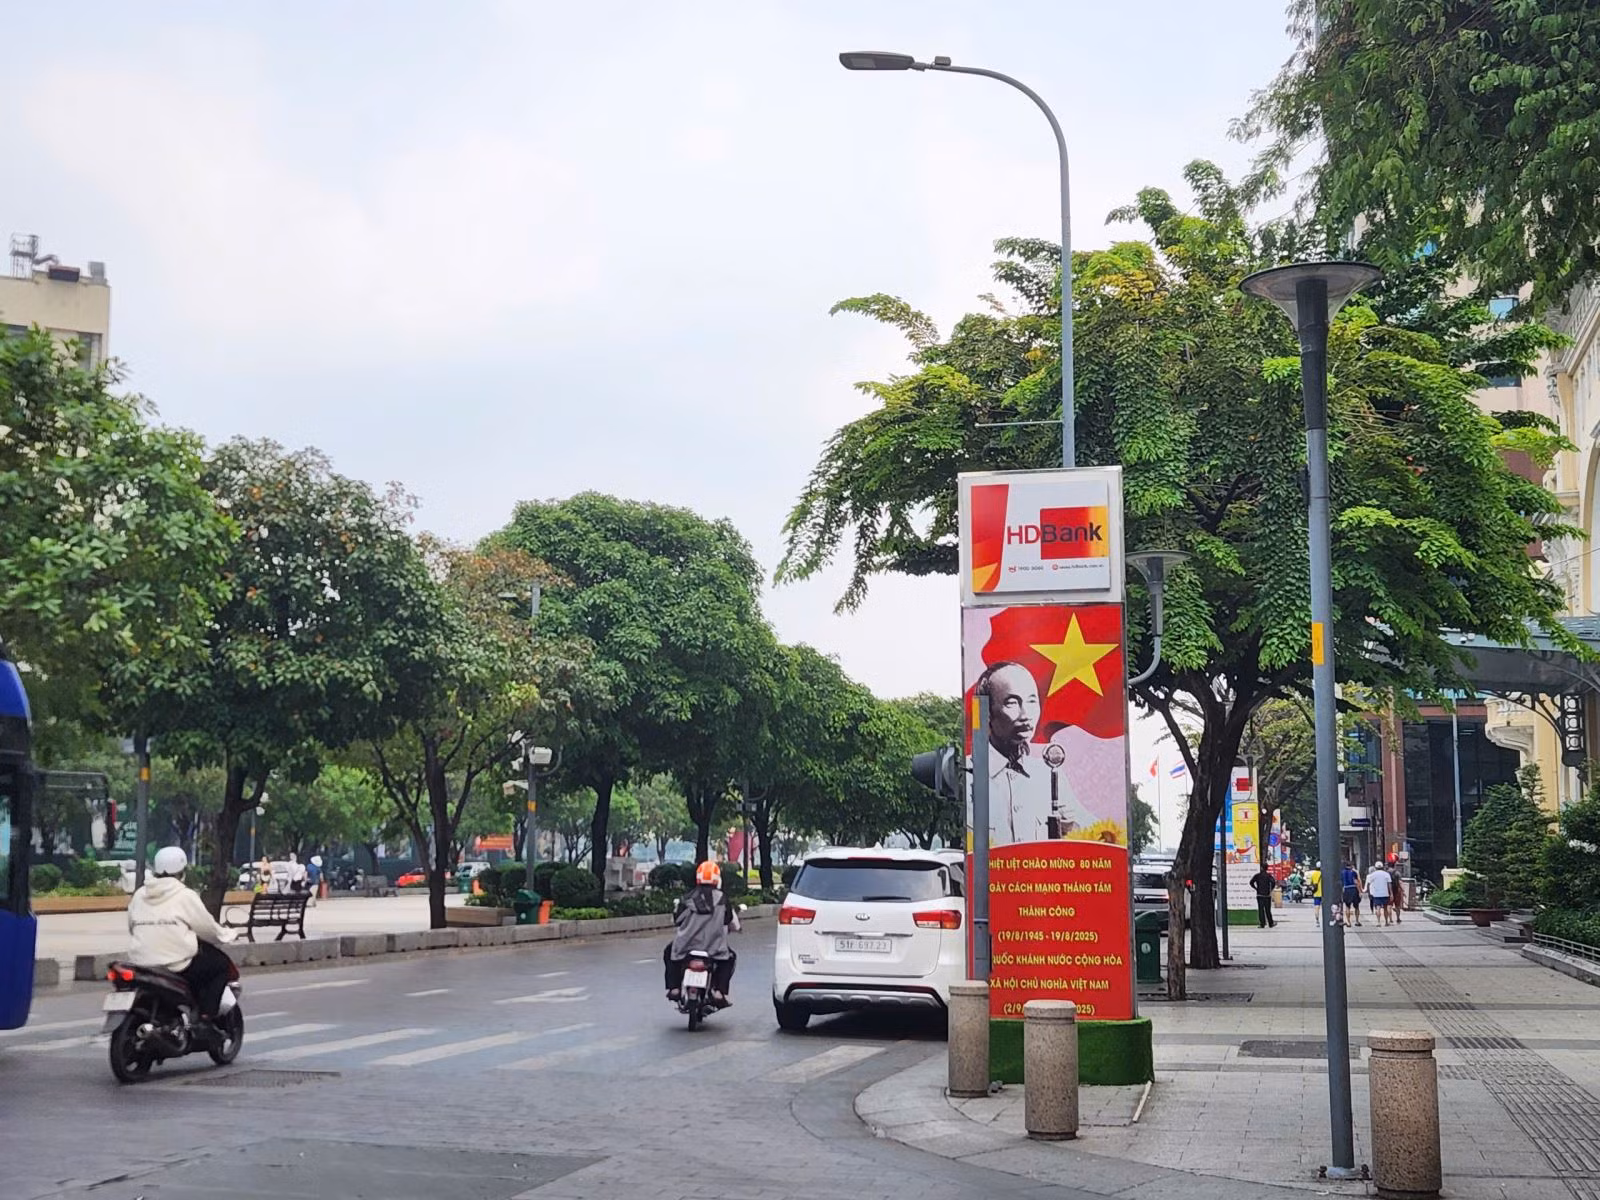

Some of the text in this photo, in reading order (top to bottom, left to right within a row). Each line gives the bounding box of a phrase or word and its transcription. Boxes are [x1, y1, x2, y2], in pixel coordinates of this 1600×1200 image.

[1007, 522, 1103, 544] HDBank
[988, 857, 1111, 871] HIỆT LIỆT CHÀO MỪNG 80 NĂM
[989, 882, 1111, 895] GÀY CÁCH MẠNG THÁNG TÁM
[1018, 905, 1075, 916] THÀNH CÔNG
[998, 930, 1044, 942] (19/8/1945
[1051, 931, 1098, 942] 19/8/2025)
[1016, 954, 1046, 965] KHÁNH
[1047, 953, 1073, 965] NƯỚC
[1075, 953, 1102, 967] CỘNG
[1104, 954, 1122, 965] HÒA
[1003, 976, 1019, 991] HỘI
[1020, 977, 1038, 989] CHỦ
[1071, 977, 1088, 991] VIỆT
[1090, 979, 1108, 990] NAM
